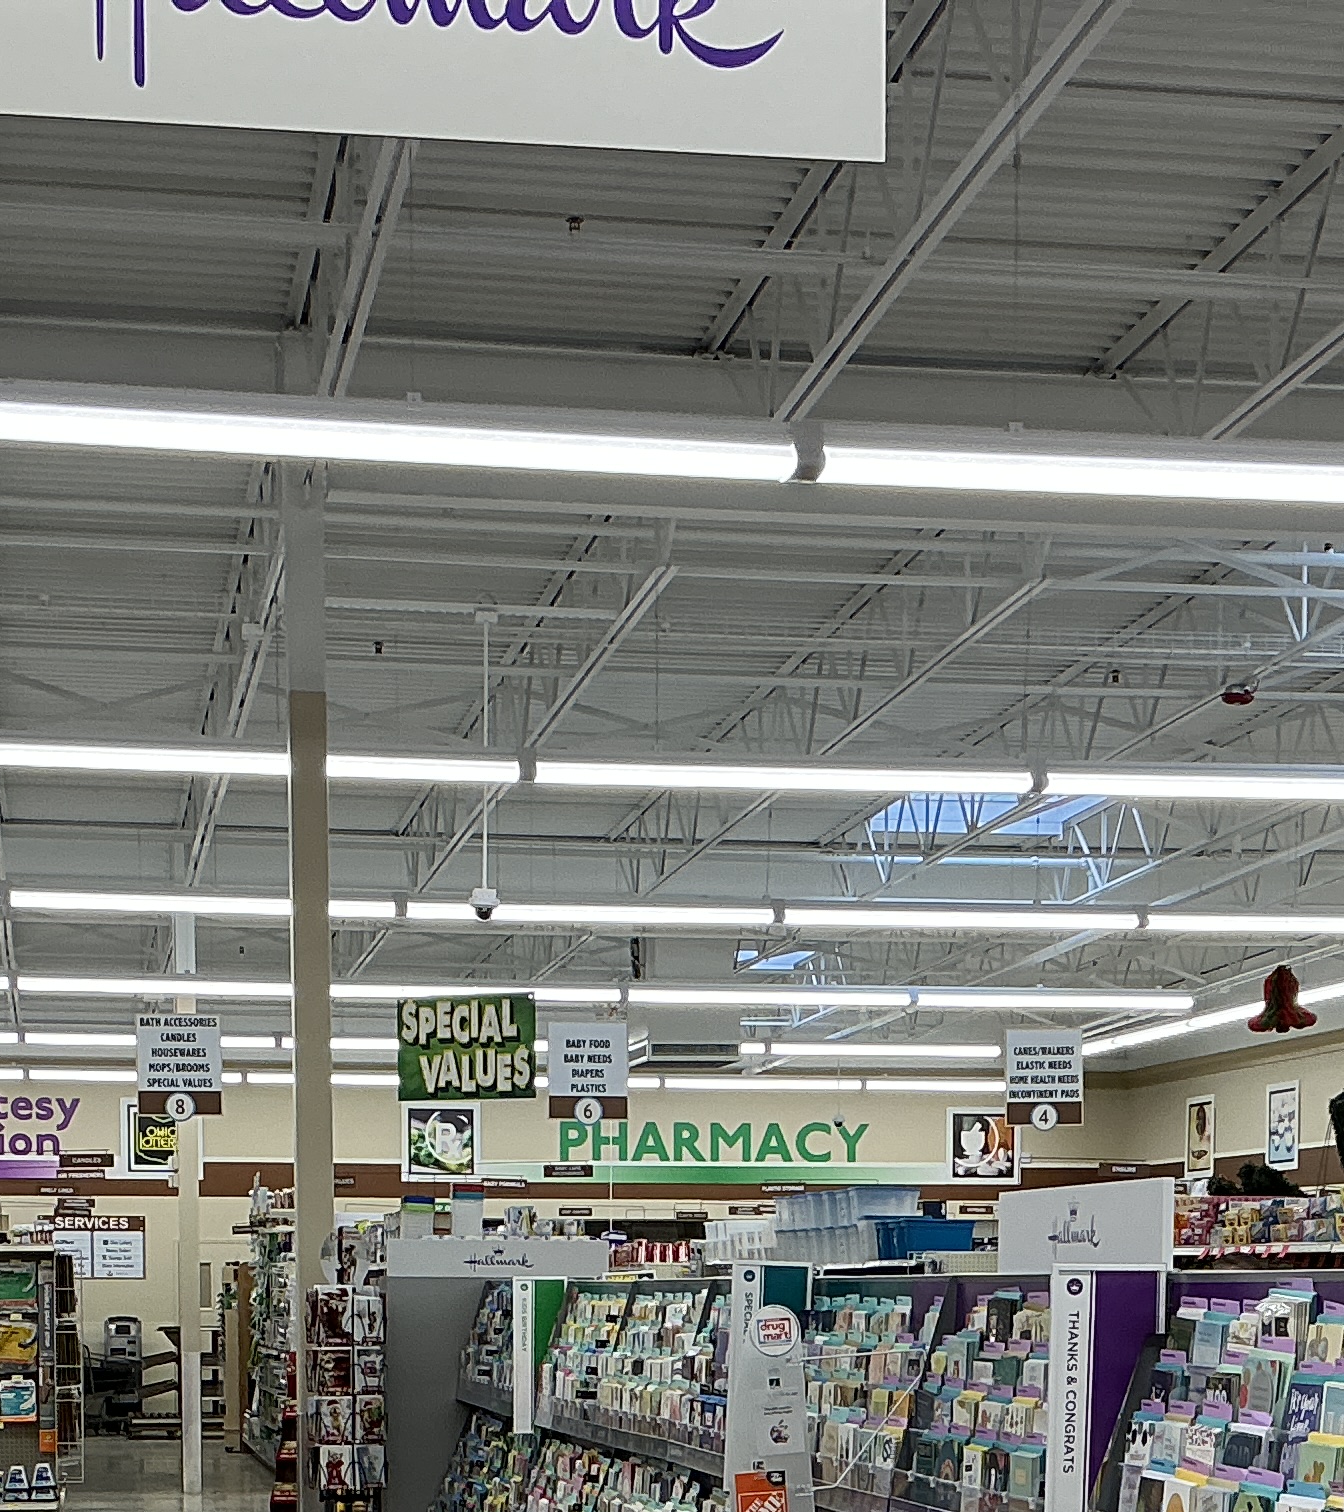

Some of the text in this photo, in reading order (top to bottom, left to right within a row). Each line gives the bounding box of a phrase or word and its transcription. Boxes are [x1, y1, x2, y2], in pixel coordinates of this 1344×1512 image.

[140, 1017, 217, 1027] BATH ACCESSORIES
[160, 1033, 197, 1043] CANDLES
[565, 1039, 610, 1048] BABY FOOD
[151, 1048, 207, 1058] HOUSEWARES
[1013, 1046, 1075, 1056] CANES/WALKERS
[563, 1053, 613, 1064] BABY NEEDS
[148, 1063, 210, 1073] MOPS/BROOMS
[1016, 1060, 1072, 1070] ELASTIC NEEDS
[571, 1068, 604, 1078] DIAPERS
[146, 1078, 213, 1088] SPECIAL VALUES
[1009, 1074, 1080, 1084] HOME HEALTH NEEDS
[570, 1083, 606, 1093] PLASTICS
[1009, 1089, 1080, 1099] INCONTINENT PADS
[175, 1099, 185, 1114] 8
[583, 1103, 593, 1119] 6
[1038, 1109, 1049, 1125] 4
[559, 1121, 869, 1162] PHARMACY
[54, 1216, 129, 1229] SERVICES
[1047, 1214, 1102, 1257] Hallmark
[463, 1252, 534, 1273] Hallmark
[760, 1323, 785, 1332] drug
[763, 1331, 792, 1341] mart
[1062, 1311, 1080, 1474] THANKS & CONGRATS
